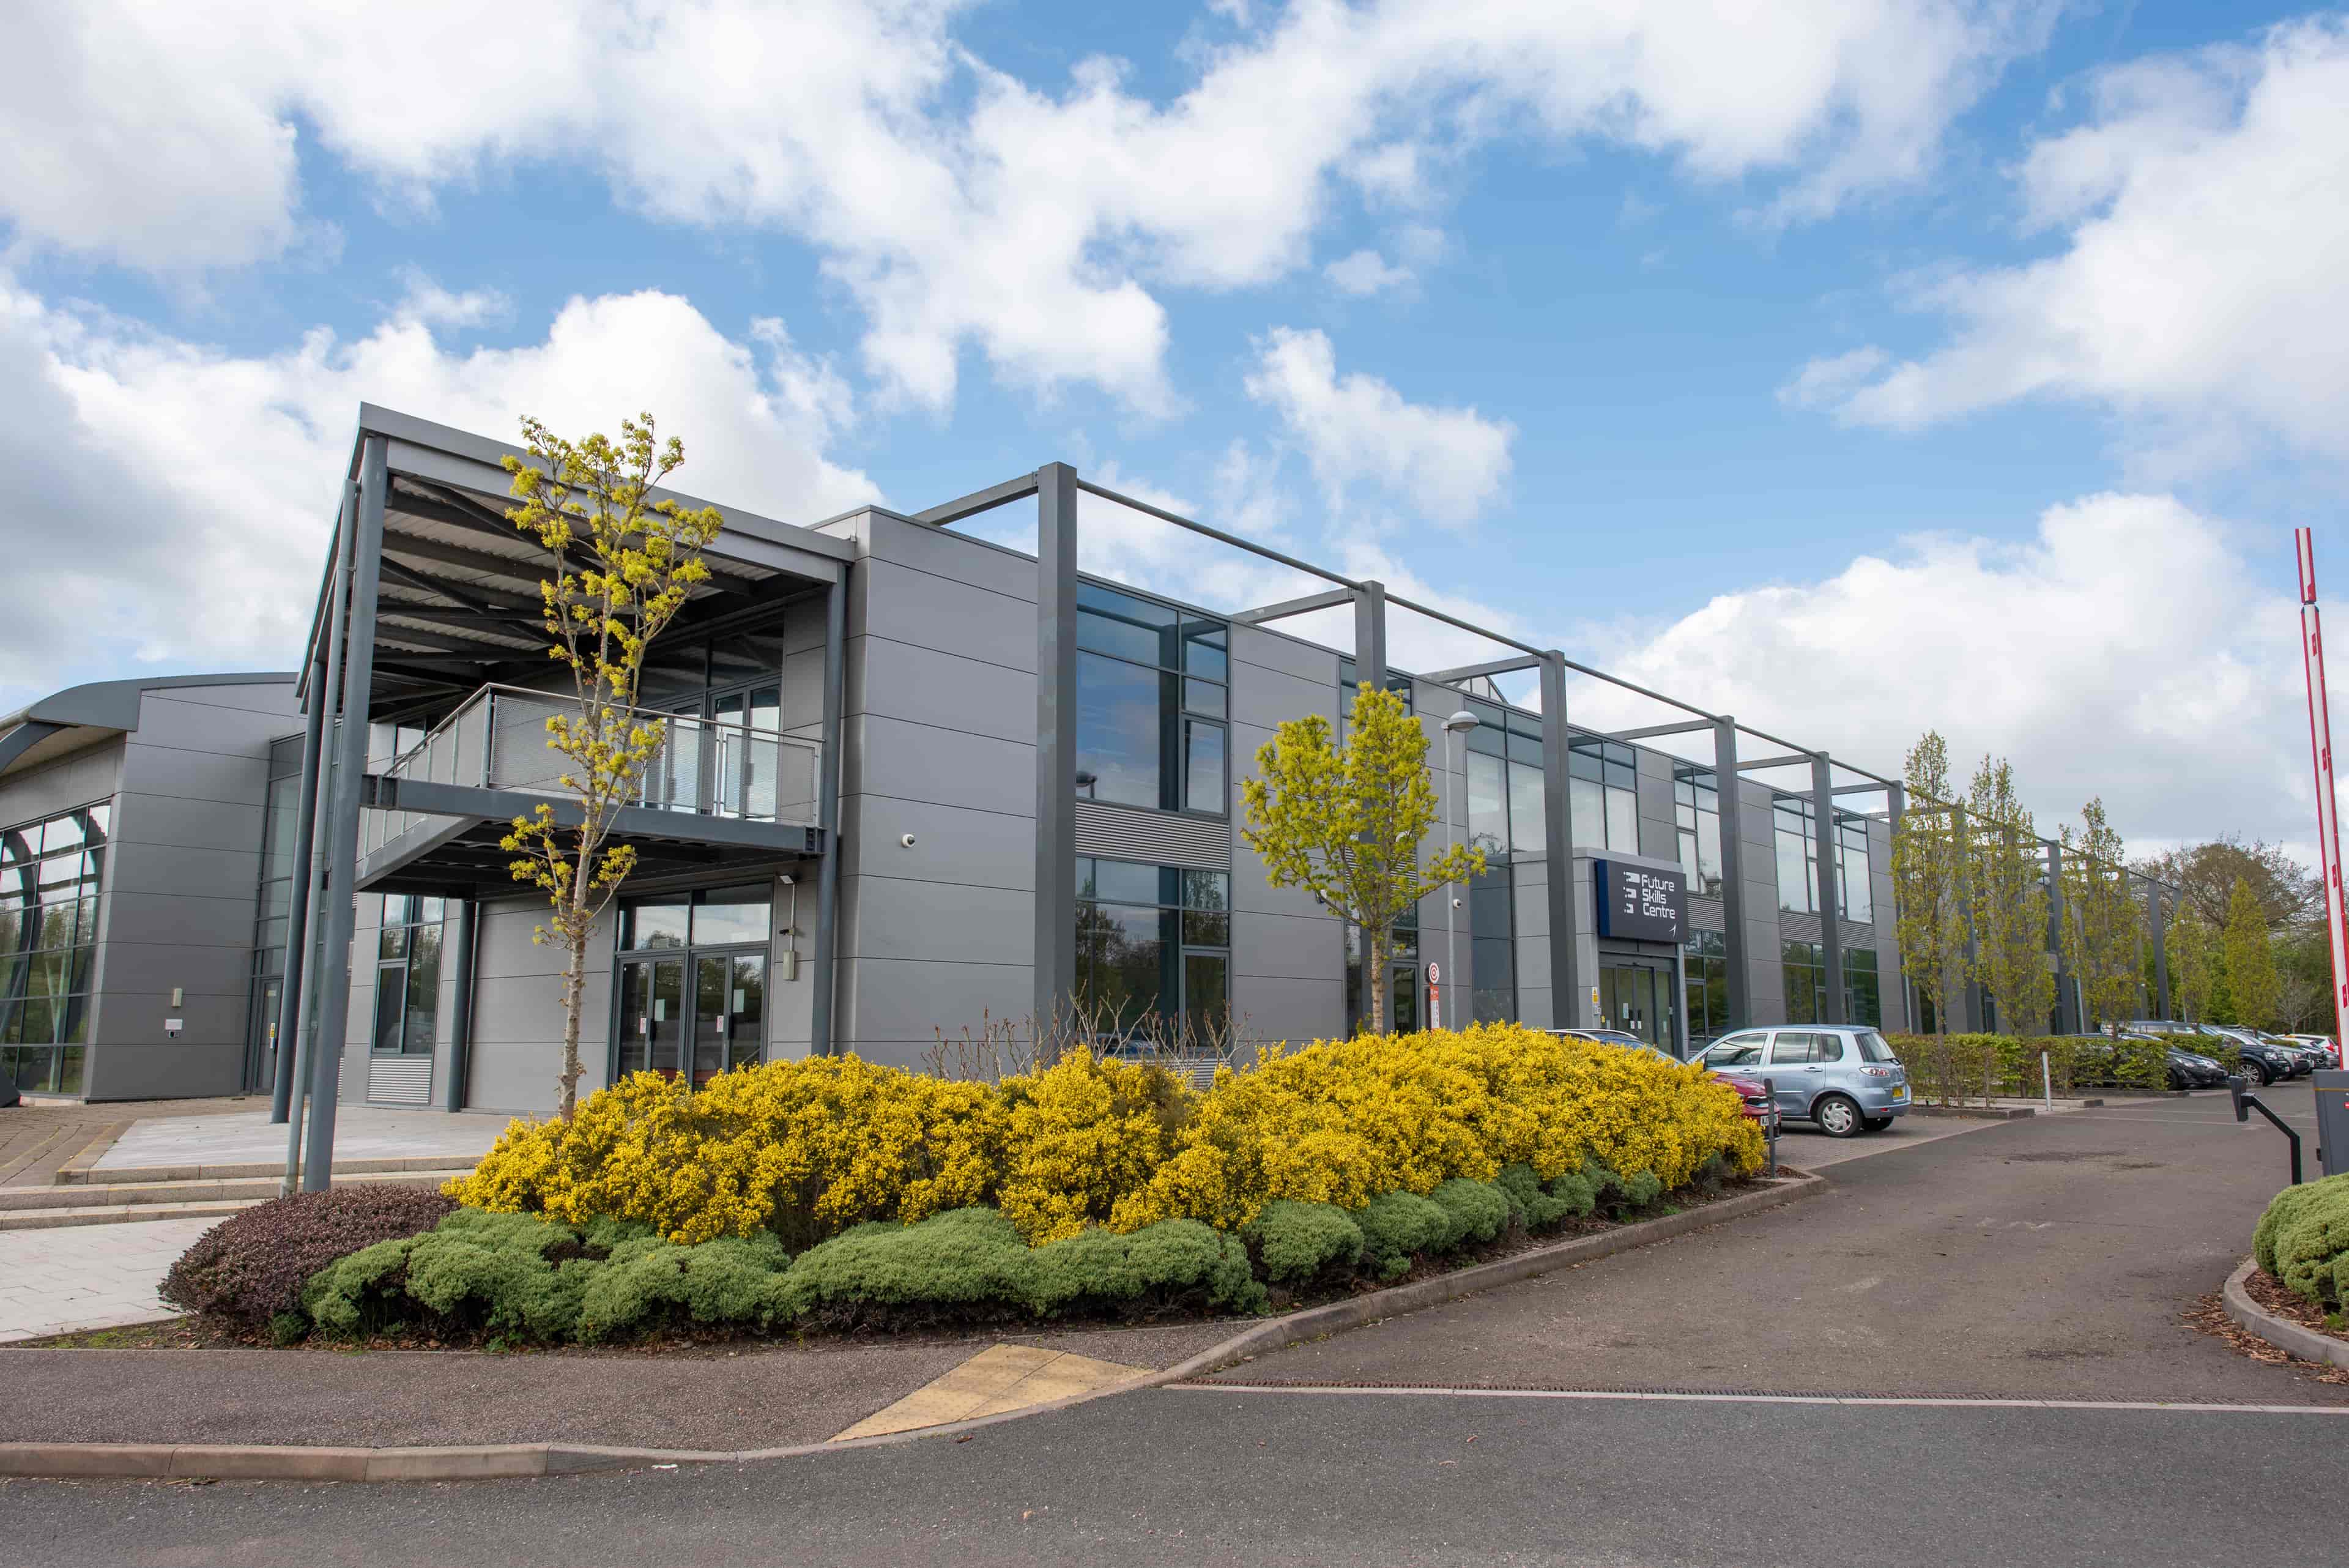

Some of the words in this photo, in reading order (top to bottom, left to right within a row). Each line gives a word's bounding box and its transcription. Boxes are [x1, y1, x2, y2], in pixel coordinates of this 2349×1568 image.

[1641, 874, 1674, 891] Future
[1642, 888, 1666, 904] Skills
[1642, 902, 1675, 920] Centre
